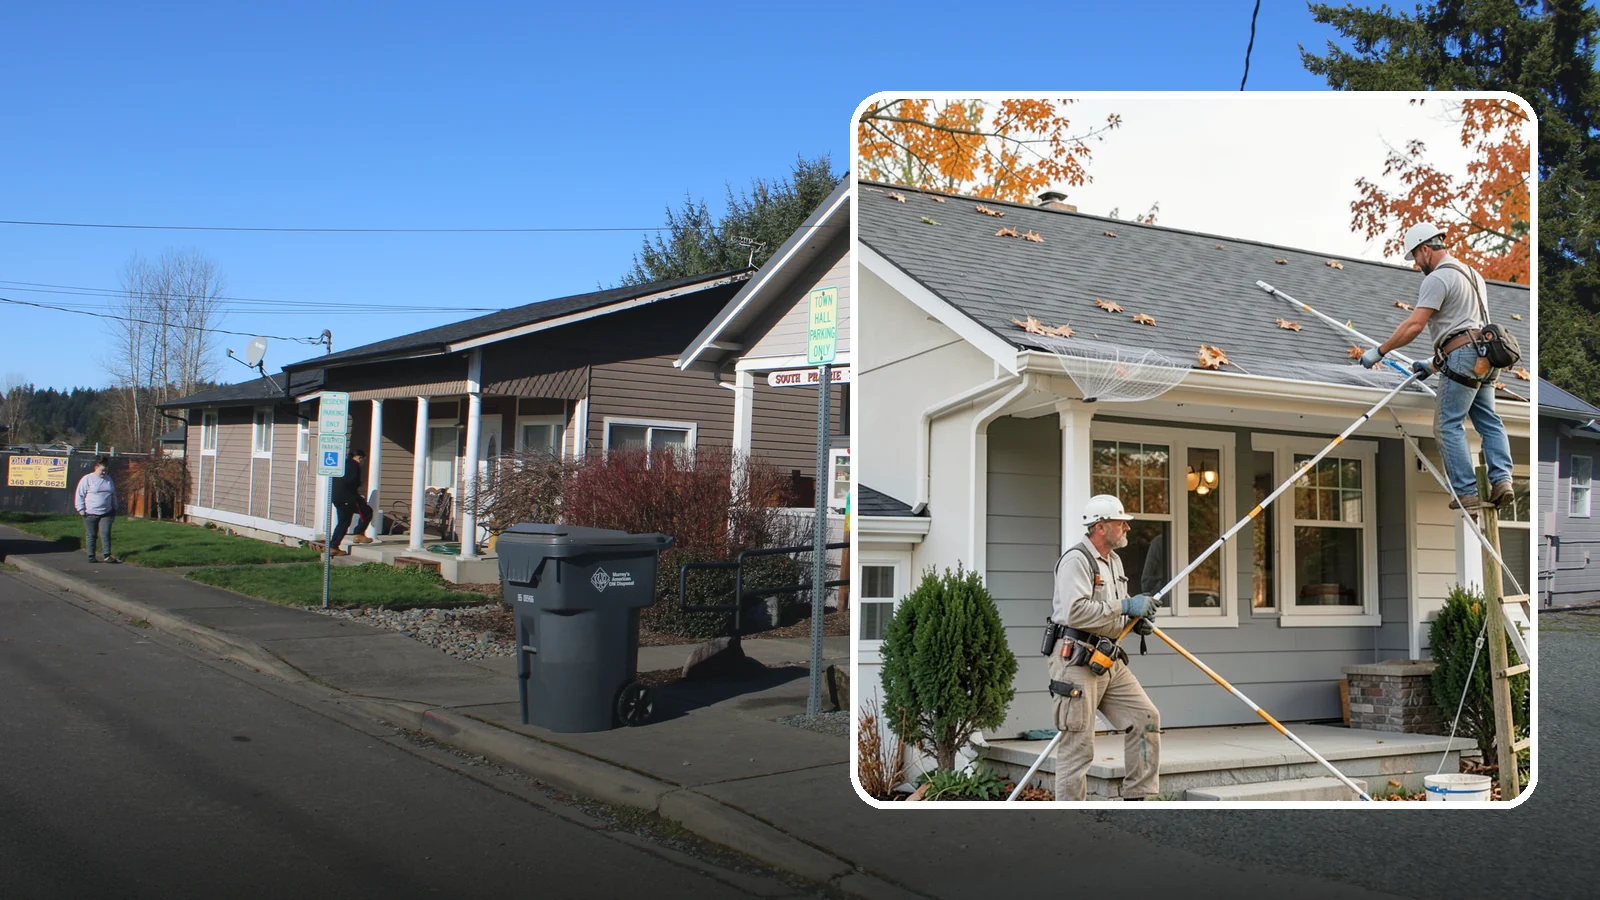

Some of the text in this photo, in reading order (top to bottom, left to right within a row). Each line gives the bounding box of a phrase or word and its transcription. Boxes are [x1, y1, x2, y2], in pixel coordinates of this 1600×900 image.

[815, 295, 833, 307] TOWN
[814, 312, 831, 324] HALL
[810, 327, 835, 340] PARKING
[813, 344, 831, 357] ONLY
[775, 373, 801, 384] SOUTH
[807, 370, 842, 382] PRIE
